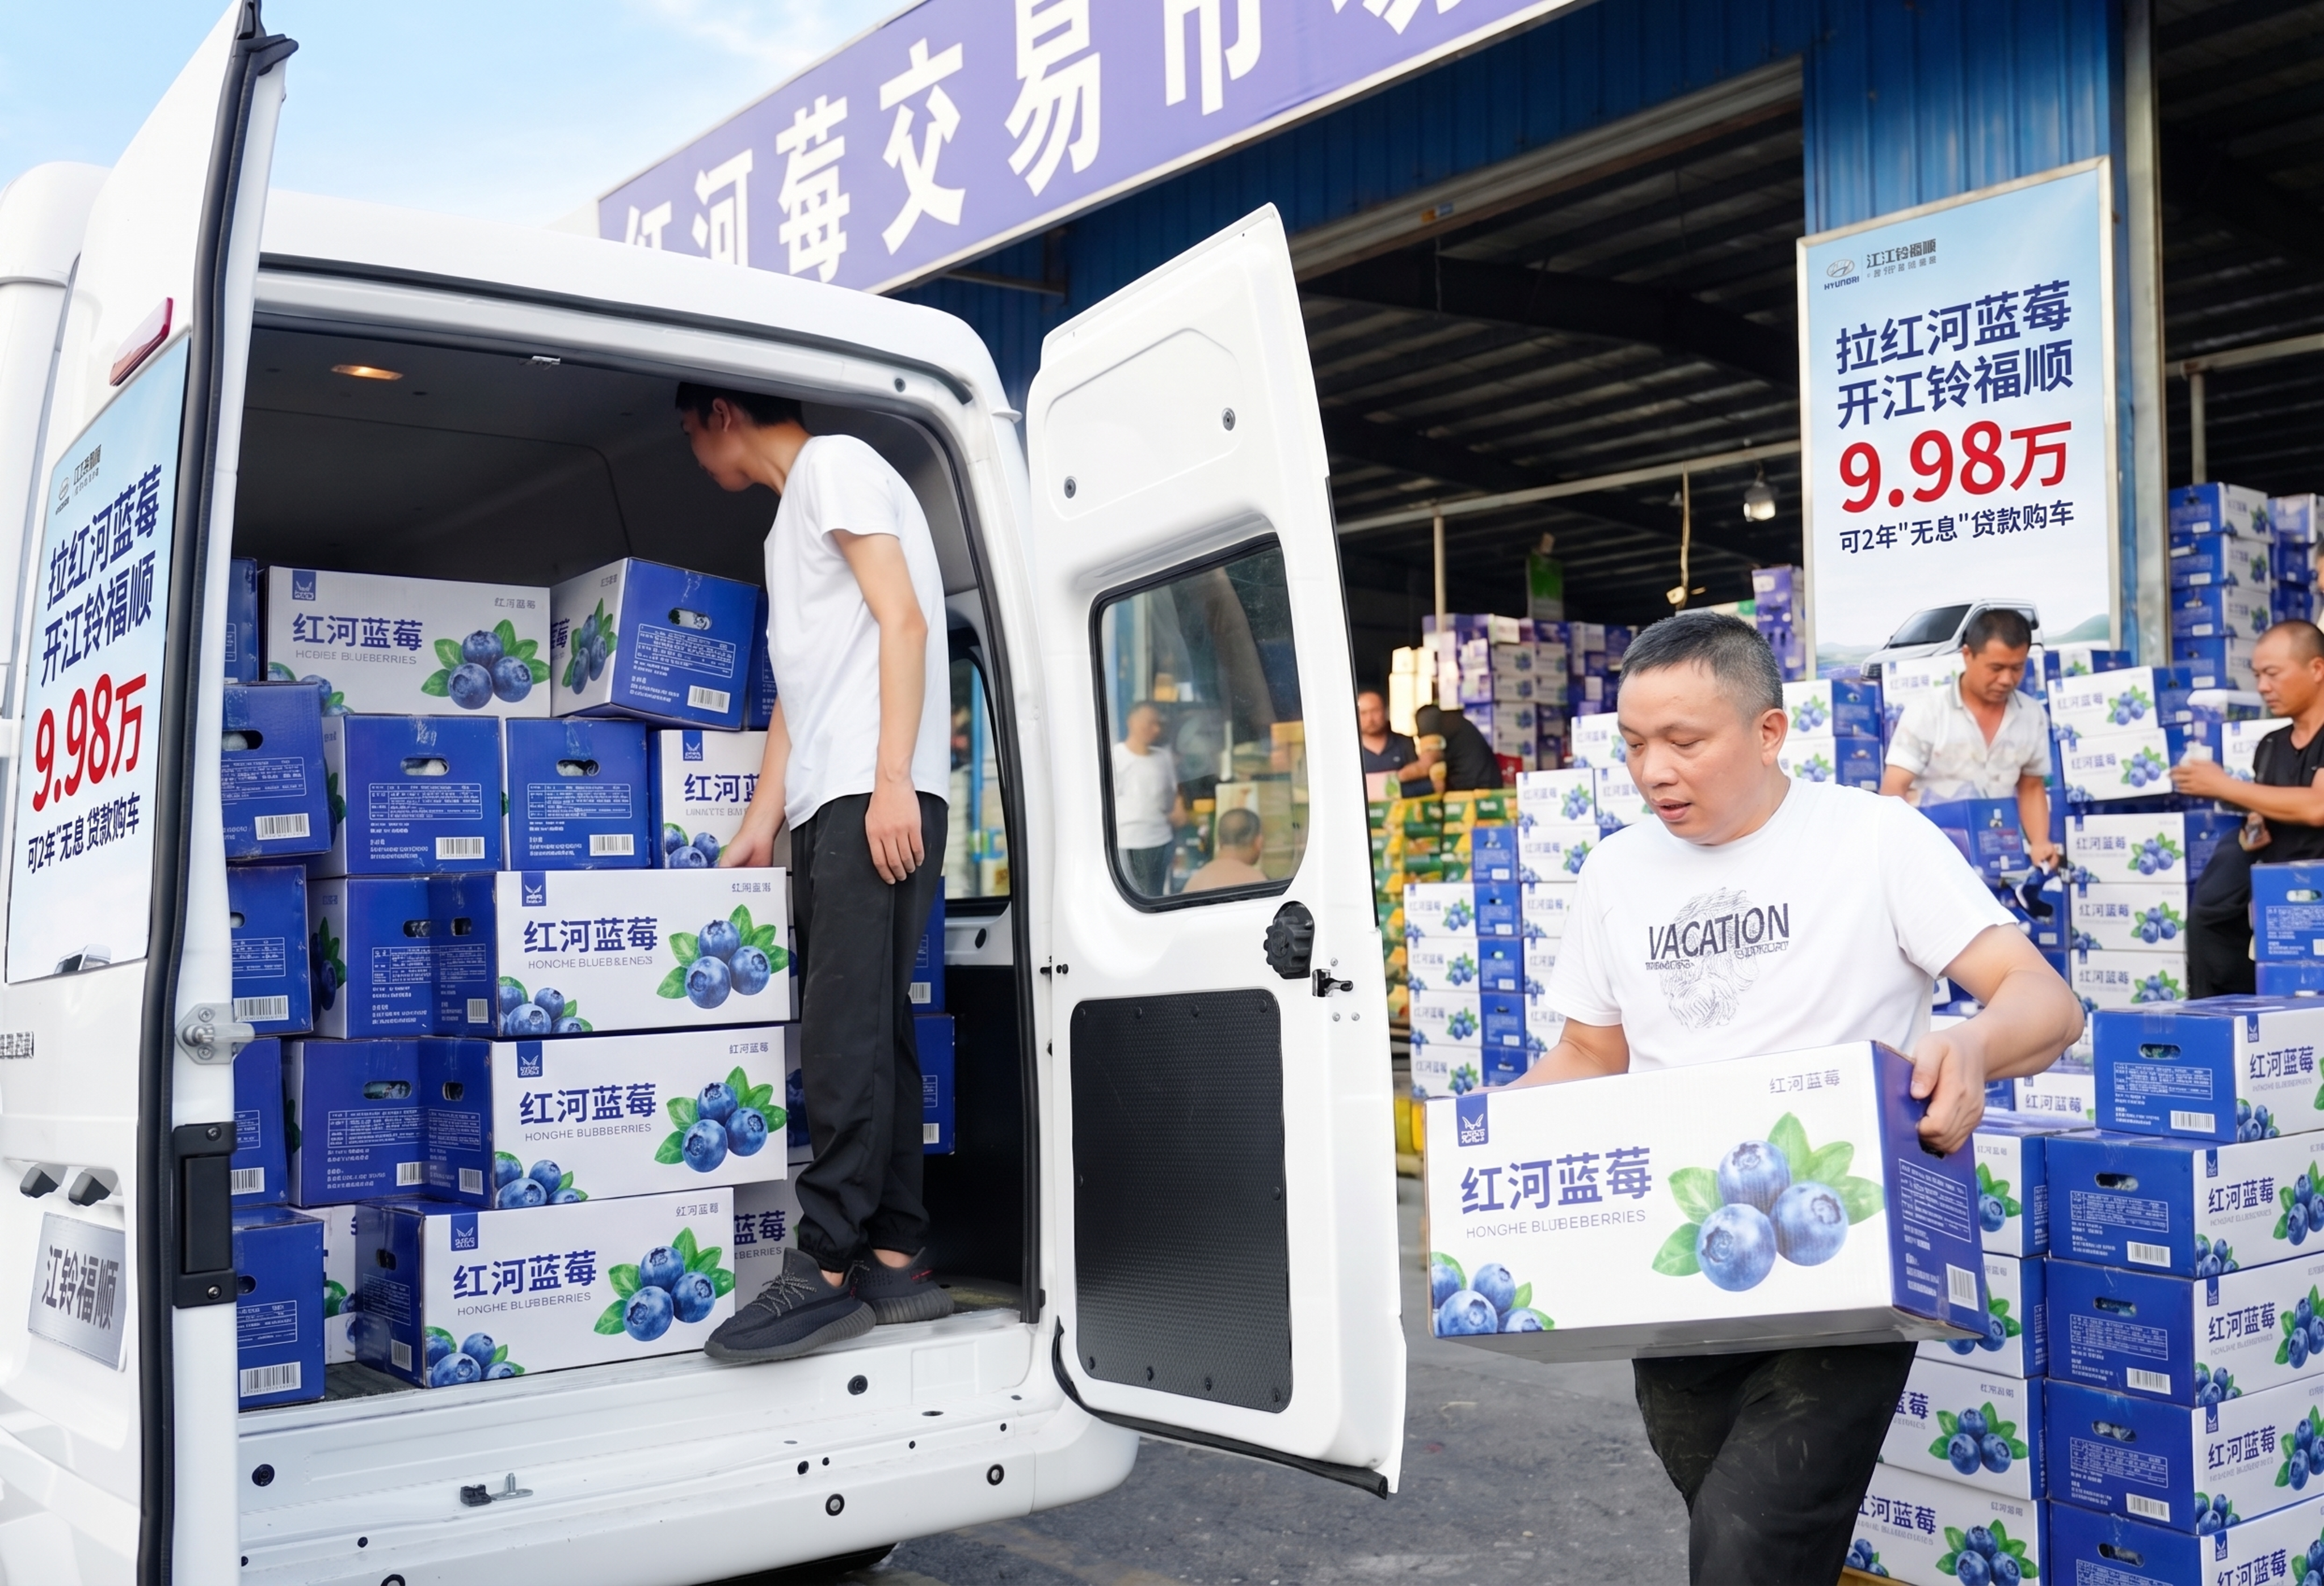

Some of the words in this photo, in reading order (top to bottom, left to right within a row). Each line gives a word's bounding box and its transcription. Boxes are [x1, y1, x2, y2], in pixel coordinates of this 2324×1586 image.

[625, 0, 1475, 284] 河莓交易市
[1836, 280, 2071, 375] 拉红河蓝莓
[1838, 339, 2073, 429] 开江铃福顺
[1839, 420, 2072, 513] 9.98万
[47, 464, 162, 611] 拉红河蓝莓
[41, 550, 157, 687] 开江铃福顺
[292, 613, 423, 651] 红河蓝莓
[32, 673, 147, 812] 9.98万
[524, 917, 658, 953] 红河蓝莓
[1649, 903, 1790, 960] VACATION
[1770, 1069, 1839, 1094] 红河蓝莓
[2250, 1045, 2314, 1079] 红河蓝莓
[520, 1082, 656, 1125] 红河蓝莓
[525, 1129, 574, 1141] HONGHE
[1460, 1146, 1652, 1214] 红河蓝莓
[2208, 1176, 2274, 1214] 红河蓝莓
[1467, 1222, 1527, 1238] HONGHE
[41, 1244, 119, 1330] 江铃福顺
[453, 1250, 596, 1300] 红河蓝莓
[457, 1302, 508, 1316] HONGHE
[2209, 1302, 2275, 1343] 红河蓝莓
[2208, 1425, 2276, 1470] 红河蓝莓
